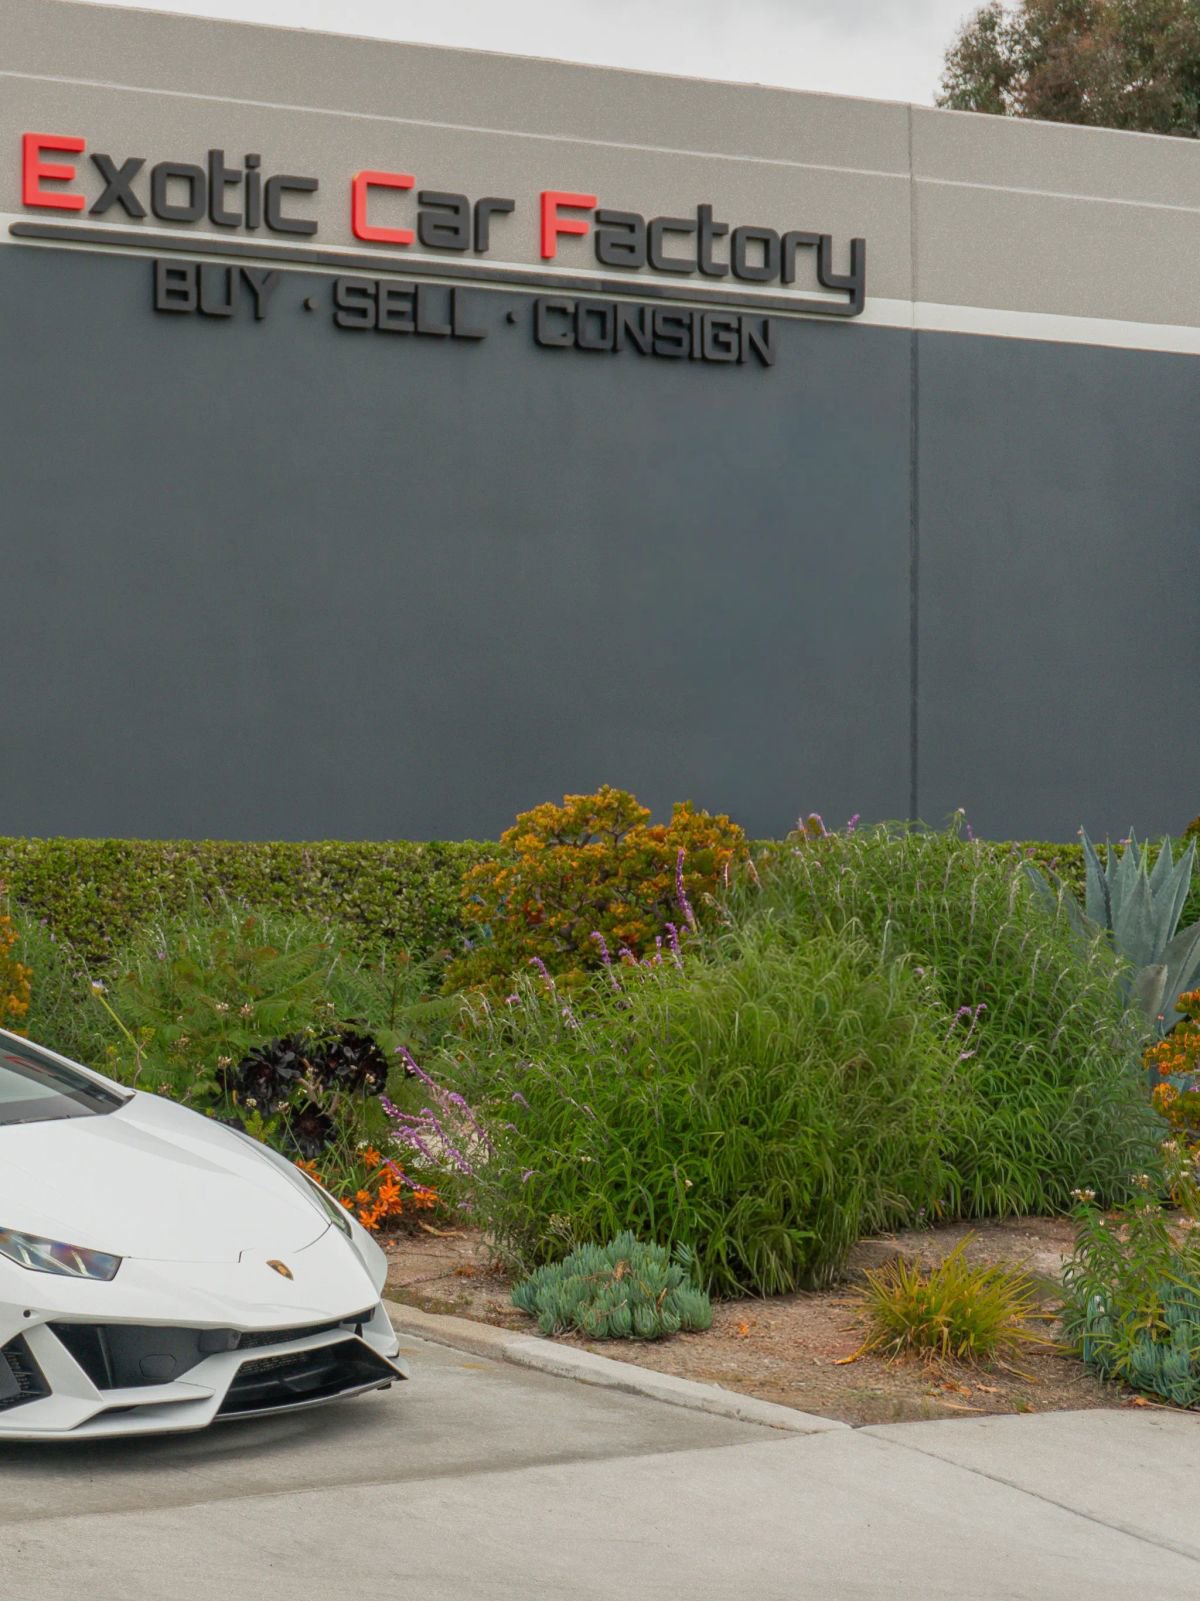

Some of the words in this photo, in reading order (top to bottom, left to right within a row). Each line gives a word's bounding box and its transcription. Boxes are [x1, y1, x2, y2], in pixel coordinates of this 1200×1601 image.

[21, 132, 319, 236] Exotic
[351, 170, 516, 253] Car
[540, 190, 866, 317] Factory
[153, 259, 279, 321] BUY
[332, 277, 490, 341] SELL
[533, 298, 776, 367] CONSIGN
